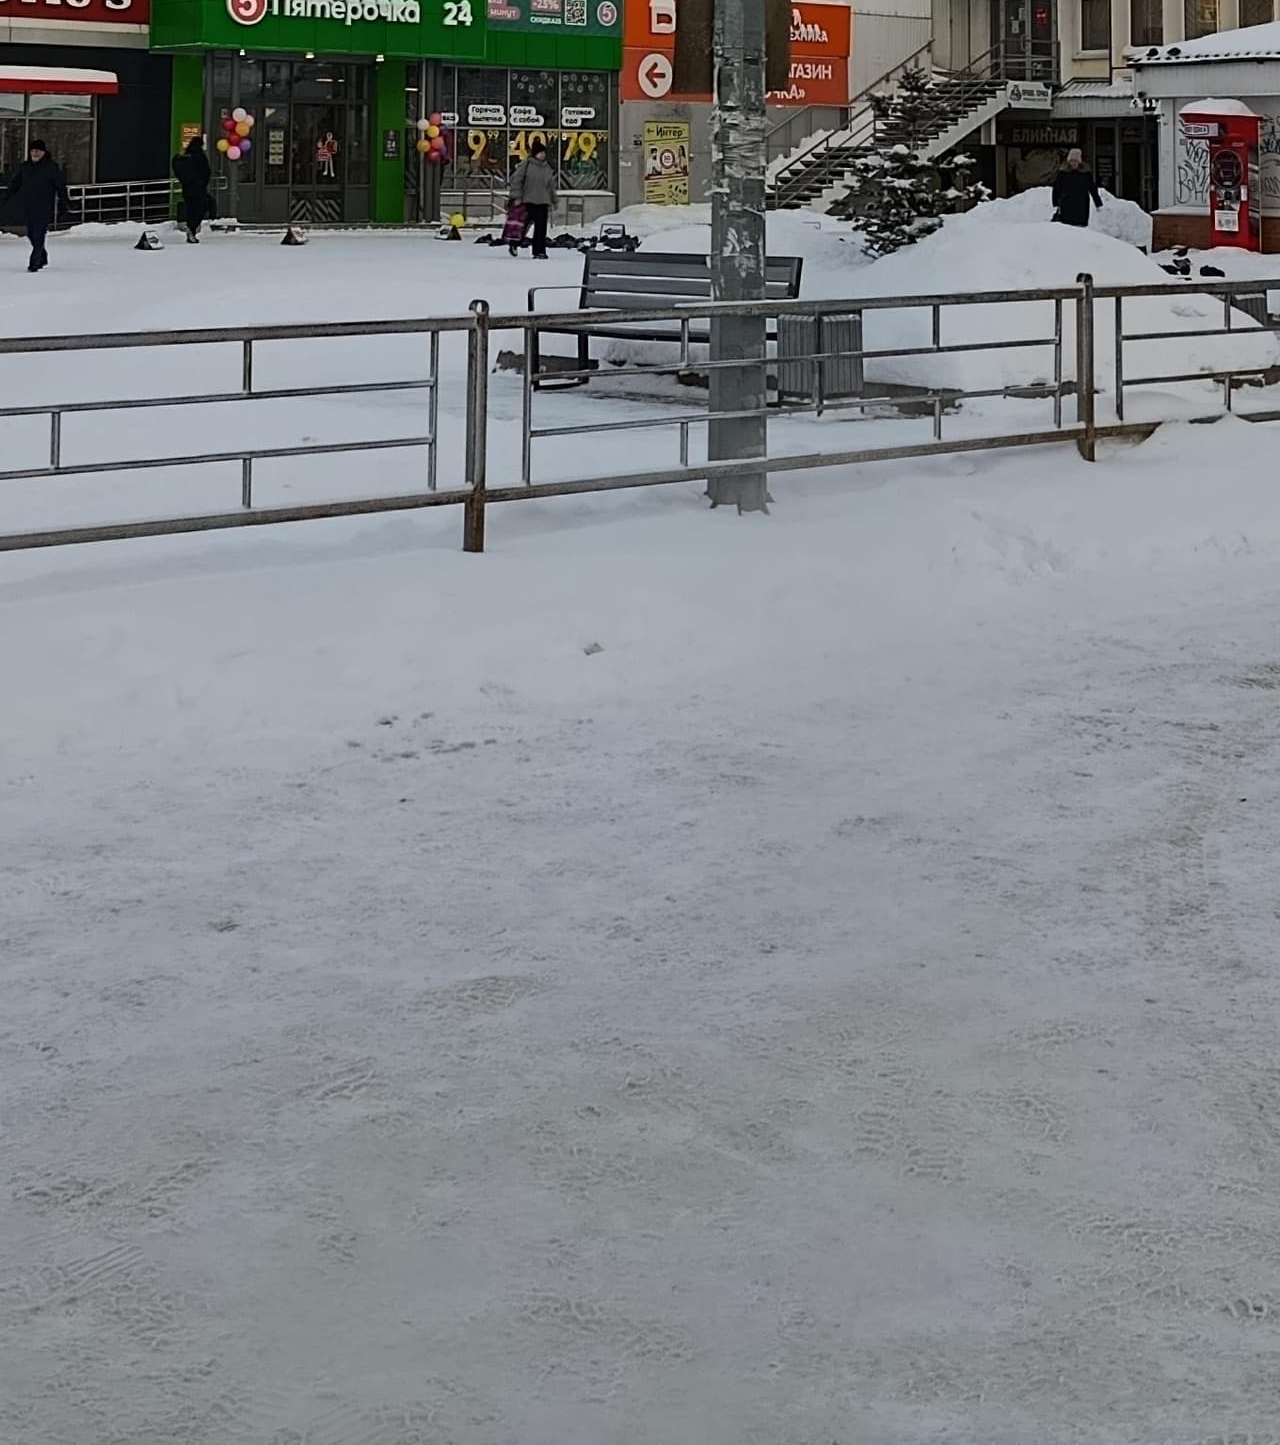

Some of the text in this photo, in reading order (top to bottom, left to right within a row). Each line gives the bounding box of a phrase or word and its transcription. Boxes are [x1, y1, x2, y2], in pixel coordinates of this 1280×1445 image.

[443, 0, 473, 26] 24
[788, 63, 832, 80] ГАЗИН
[1012, 128, 1077, 143] БЛИННАЯ
